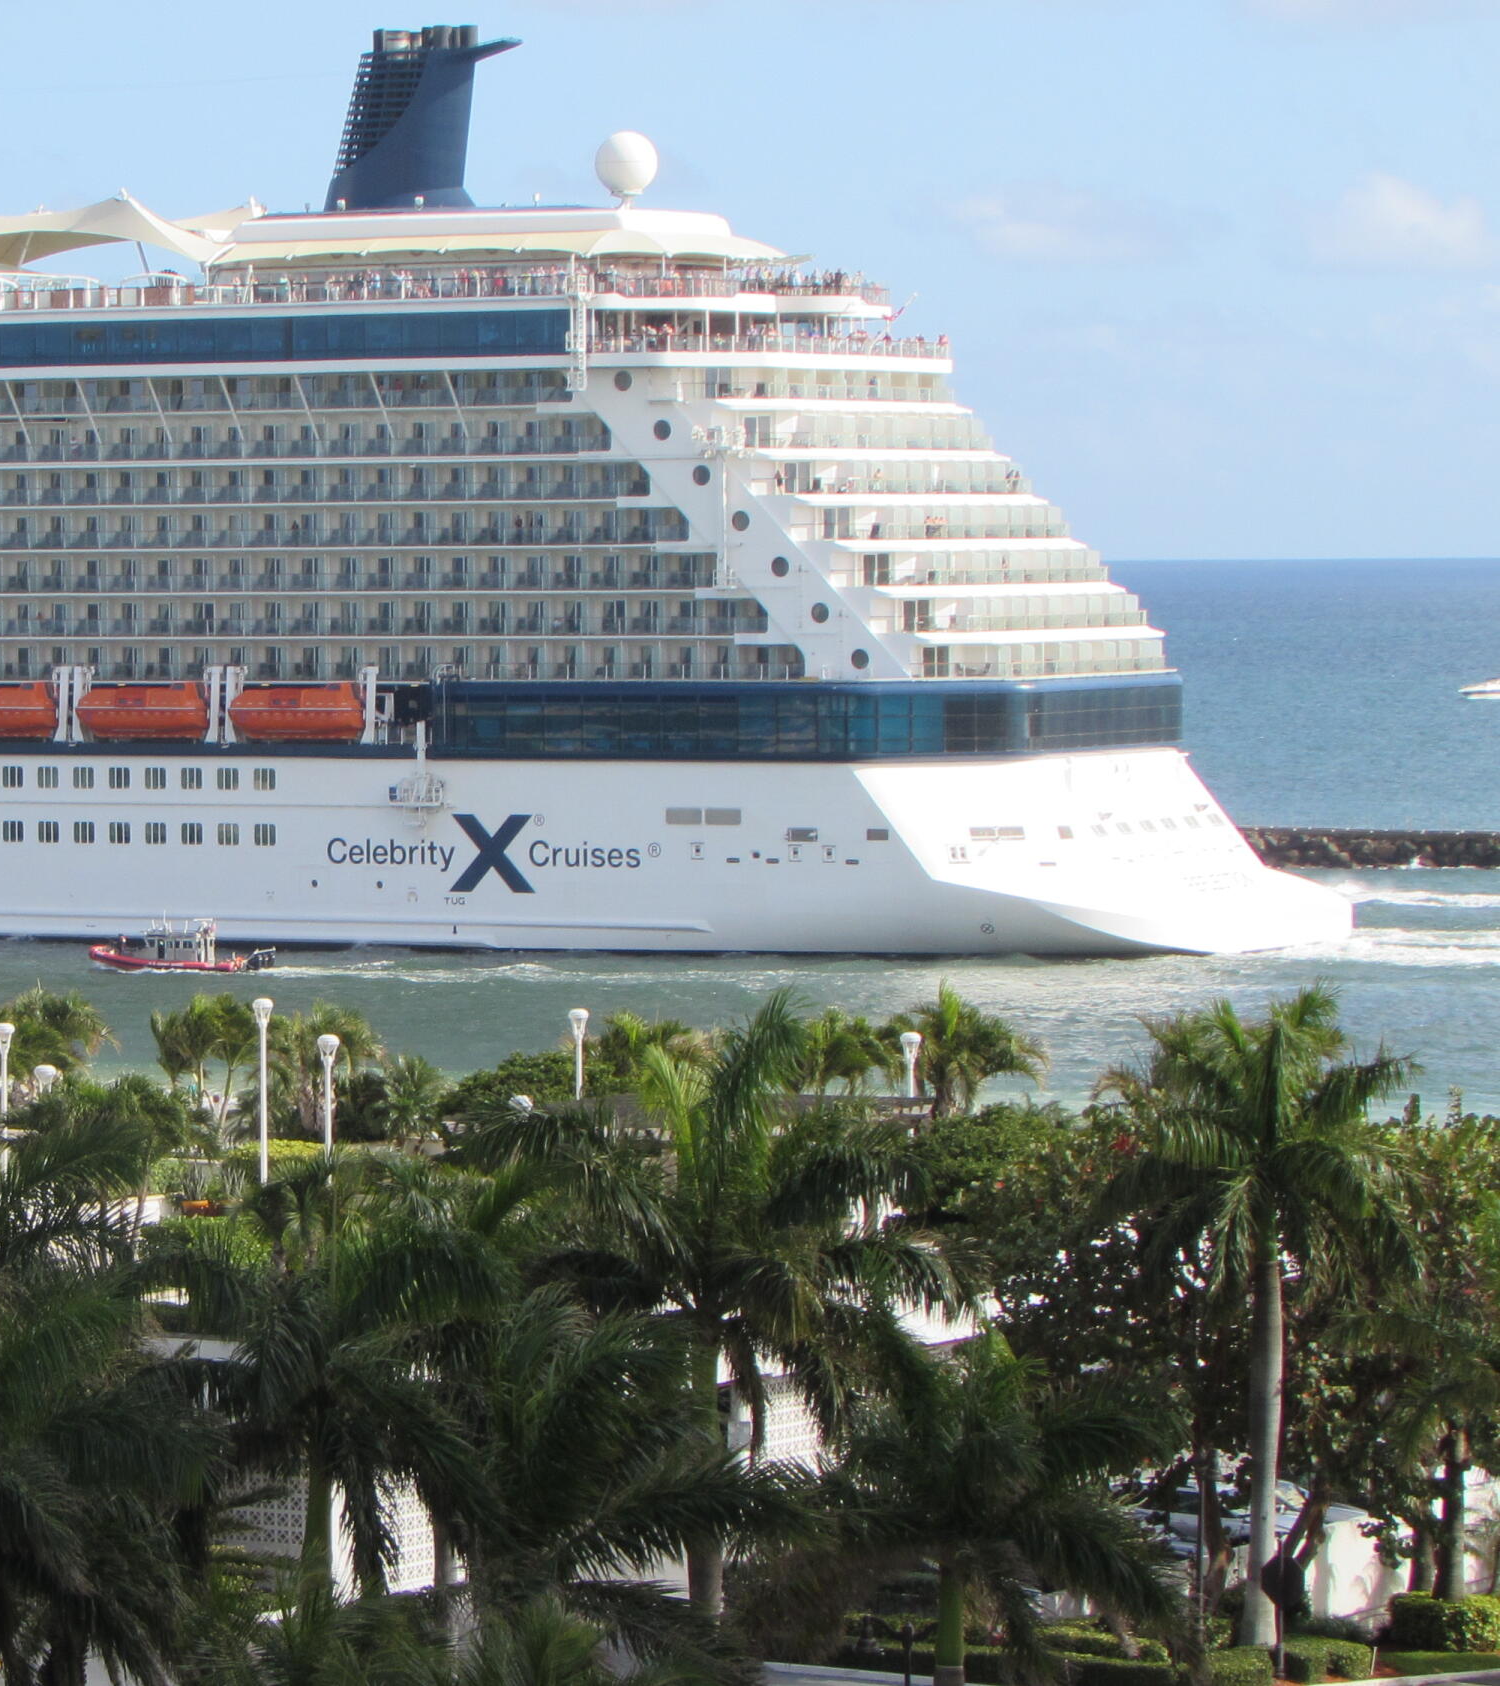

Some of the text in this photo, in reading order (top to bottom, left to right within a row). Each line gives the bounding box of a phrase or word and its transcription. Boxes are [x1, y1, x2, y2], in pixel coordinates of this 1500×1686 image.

[327, 813, 641, 893] Celebrity X Cruises
